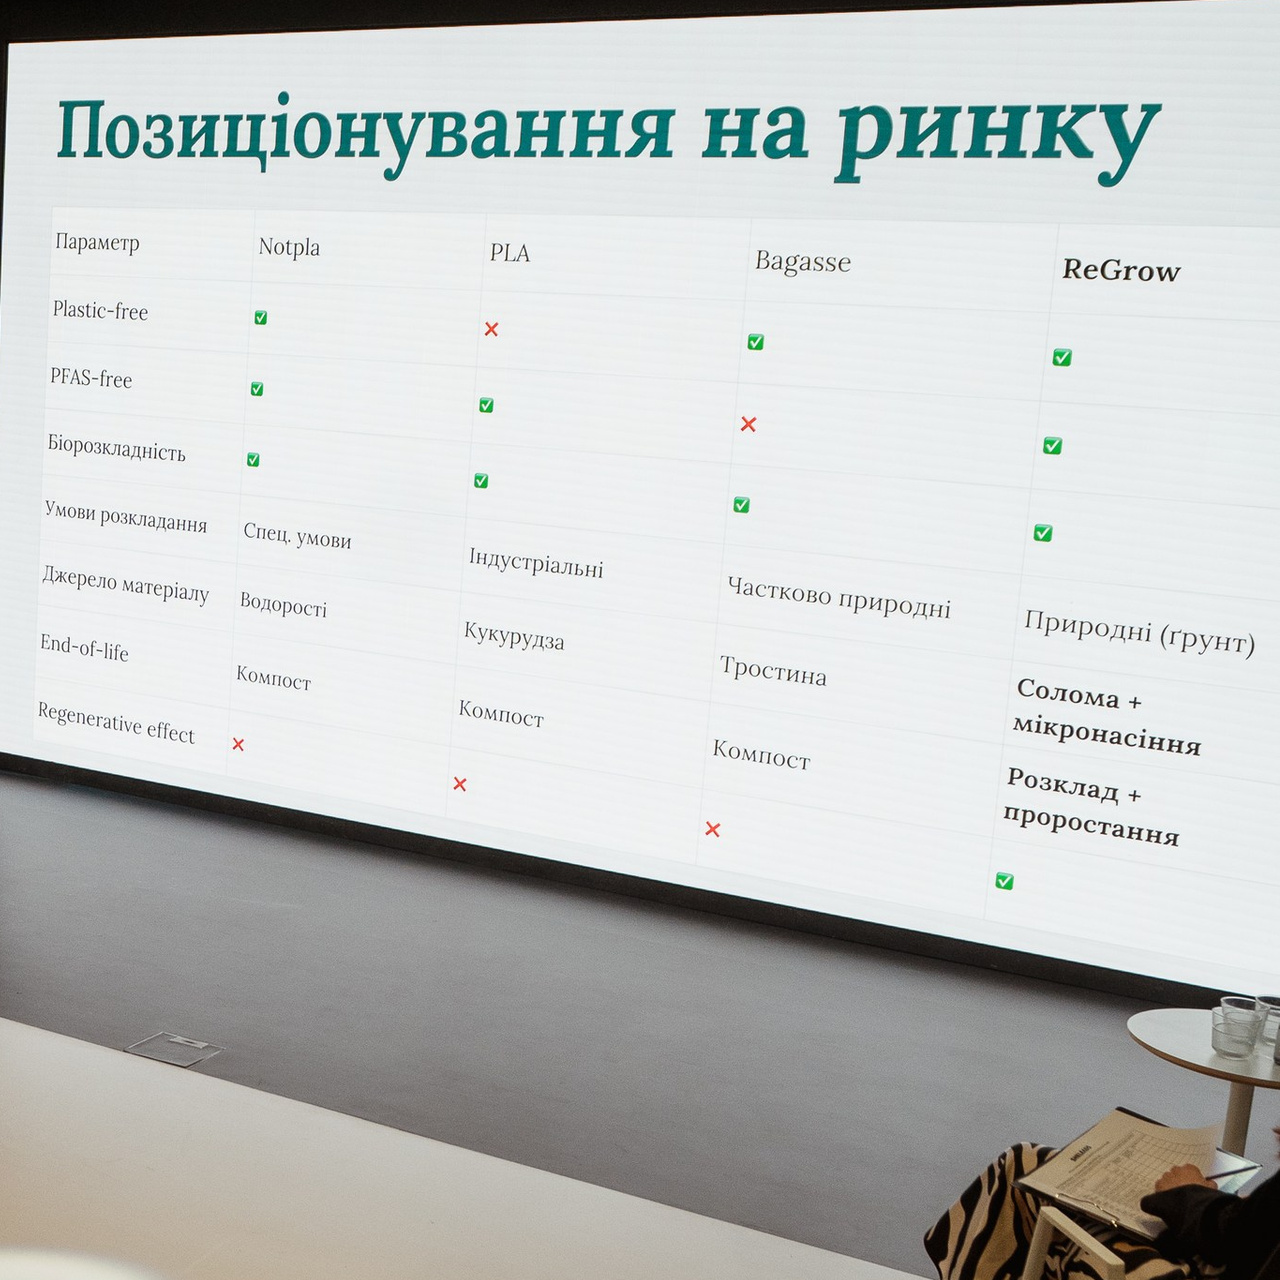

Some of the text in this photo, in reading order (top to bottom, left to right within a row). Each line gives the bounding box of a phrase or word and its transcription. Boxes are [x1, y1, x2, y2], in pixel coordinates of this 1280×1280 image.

[56, 90, 1163, 189] Позиціонування на ринку
[55, 232, 140, 257] Параметр
[258, 236, 321, 262] Notpla
[490, 242, 531, 263] PLA
[755, 249, 852, 278] Bagasse
[1061, 257, 1183, 283] ReGrow
[53, 299, 149, 322] Plastic-free
[50, 366, 133, 390] PFAS-free
[48, 433, 187, 463] Біорозкладність
[44, 499, 209, 535] Умови розкладання
[243, 521, 352, 550] Спец. умови
[469, 542, 604, 579] Індустріальні
[41, 564, 210, 608] Джерело матеріалу
[727, 575, 952, 621] Частково природні
[240, 591, 327, 619] Водорості
[40, 633, 129, 663] End-of-life
[464, 620, 565, 652] Кукурудза
[1024, 609, 1256, 661] Природні (ґрунт)
[236, 664, 312, 691] Компост
[719, 655, 828, 688] Тростина
[1017, 677, 1142, 710] Солома +
[38, 700, 196, 745] Regenerative effect
[458, 699, 545, 729] Компост
[1012, 713, 1203, 757] мікронасіння
[712, 738, 811, 772] Компост
[1006, 766, 1142, 807] Розклад +
[1002, 805, 1181, 848] проростання
